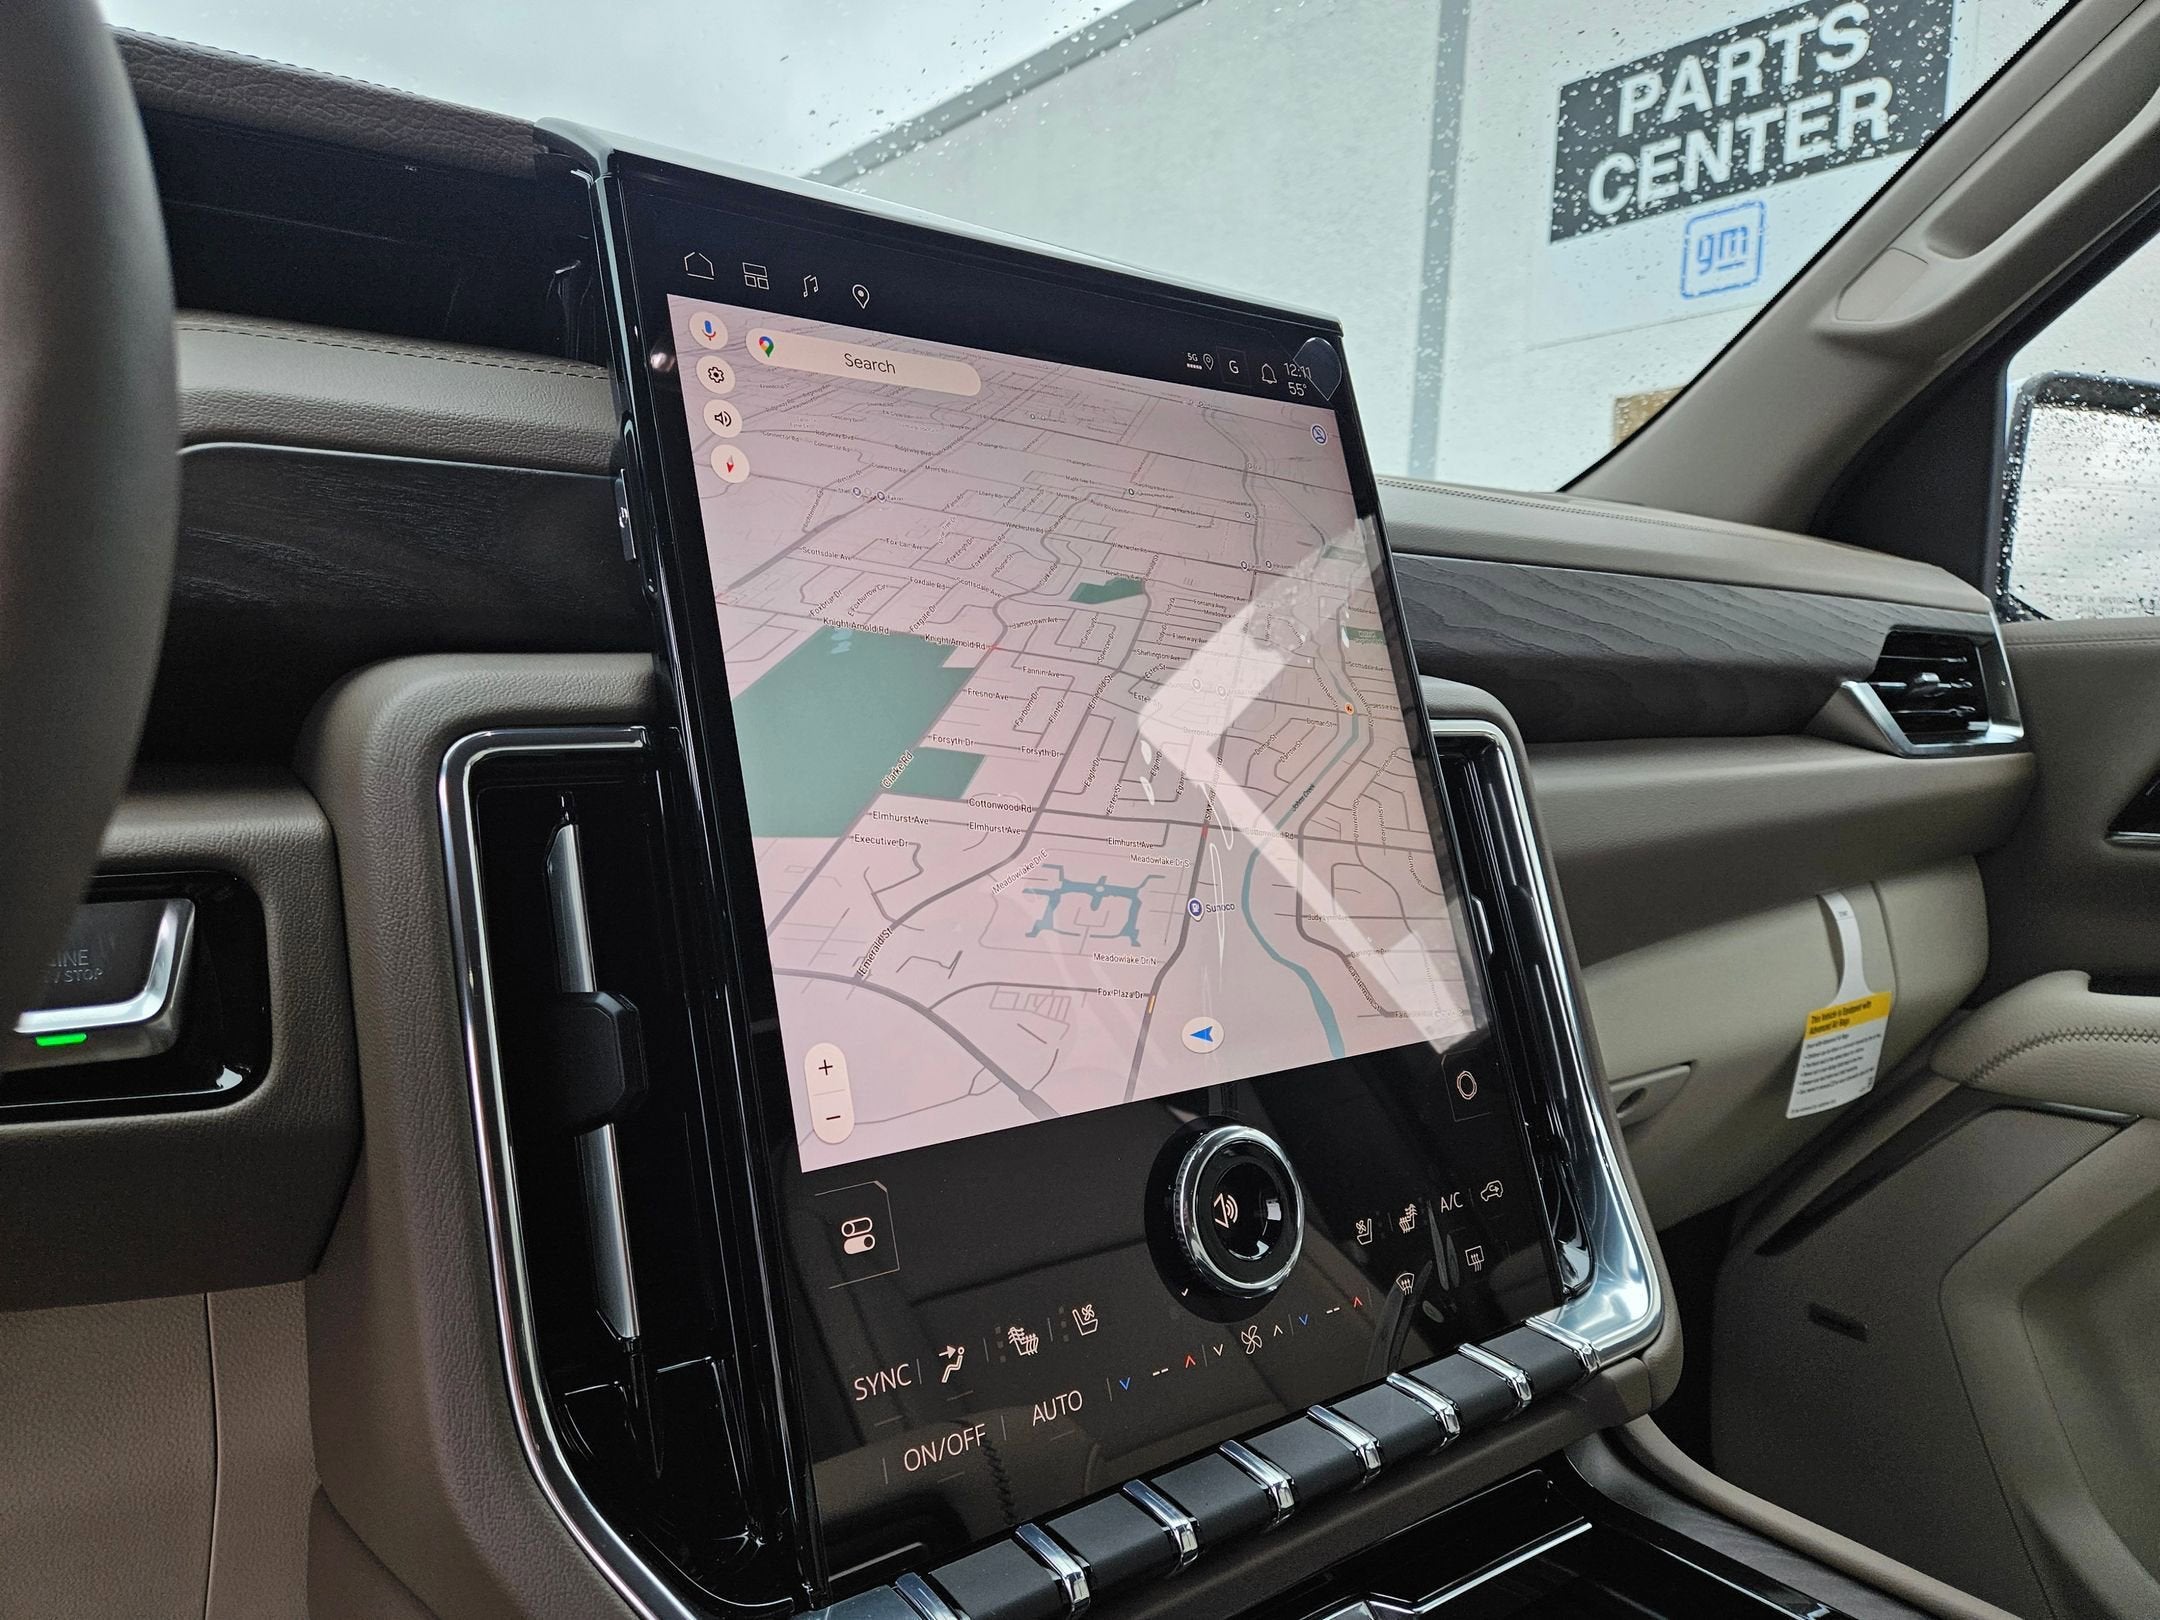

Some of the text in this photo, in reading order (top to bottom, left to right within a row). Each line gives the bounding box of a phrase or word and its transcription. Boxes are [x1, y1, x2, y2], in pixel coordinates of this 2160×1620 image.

[1617, 2, 1871, 137] PARTS
[1588, 76, 1893, 216] CENTER
[1698, 225, 1749, 276] gm
[843, 352, 897, 375] Search
[1187, 352, 1198, 362] 5G
[1283, 362, 1312, 379] 12:11
[802, 546, 838, 560] Scottsdale
[909, 576, 935, 588] Foxdale
[957, 577, 989, 593] Scottsdale
[810, 593, 835, 616] Foxbriar
[823, 617, 889, 635] Knight Arnold Rd
[1012, 618, 1047, 630] Jamestown
[925, 633, 986, 650] Knight Arnold Rd
[1022, 666, 1061, 678] Fannin Ave
[967, 688, 1009, 701] Fresno Ave
[1090, 681, 1107, 710] Emerald
[1049, 706, 1061, 724] Flint
[932, 733, 975, 746] Forsyth Dr
[1021, 745, 1060, 758] Forsyth Dr
[883, 752, 913, 788] Clarke Rd
[1150, 758, 1160, 777] Elgin
[1084, 766, 1097, 787] Eagle
[969, 799, 1032, 813] Cottonwood Rd
[1106, 791, 1119, 815] Estes
[872, 811, 929, 825] Elmhurst Ave
[969, 822, 1021, 835] Elmhurst Ave
[854, 834, 908, 847] Executive Dr
[1108, 837, 1141, 848] Elmhurst
[1130, 854, 1174, 866] Meadowlake
[992, 862, 1034, 895] Meadowlake
[1206, 903, 1236, 913] Sunoco
[858, 938, 884, 976] Emerald
[1094, 952, 1140, 964] Meadowlake
[1098, 987, 1144, 999] Fox Plaza Dr
[1440, 1191, 1463, 1212] A/C
[854, 1363, 912, 1401] SYNC
[1032, 1390, 1083, 1427] AUTO
[903, 1423, 986, 1473] ON/OFF
